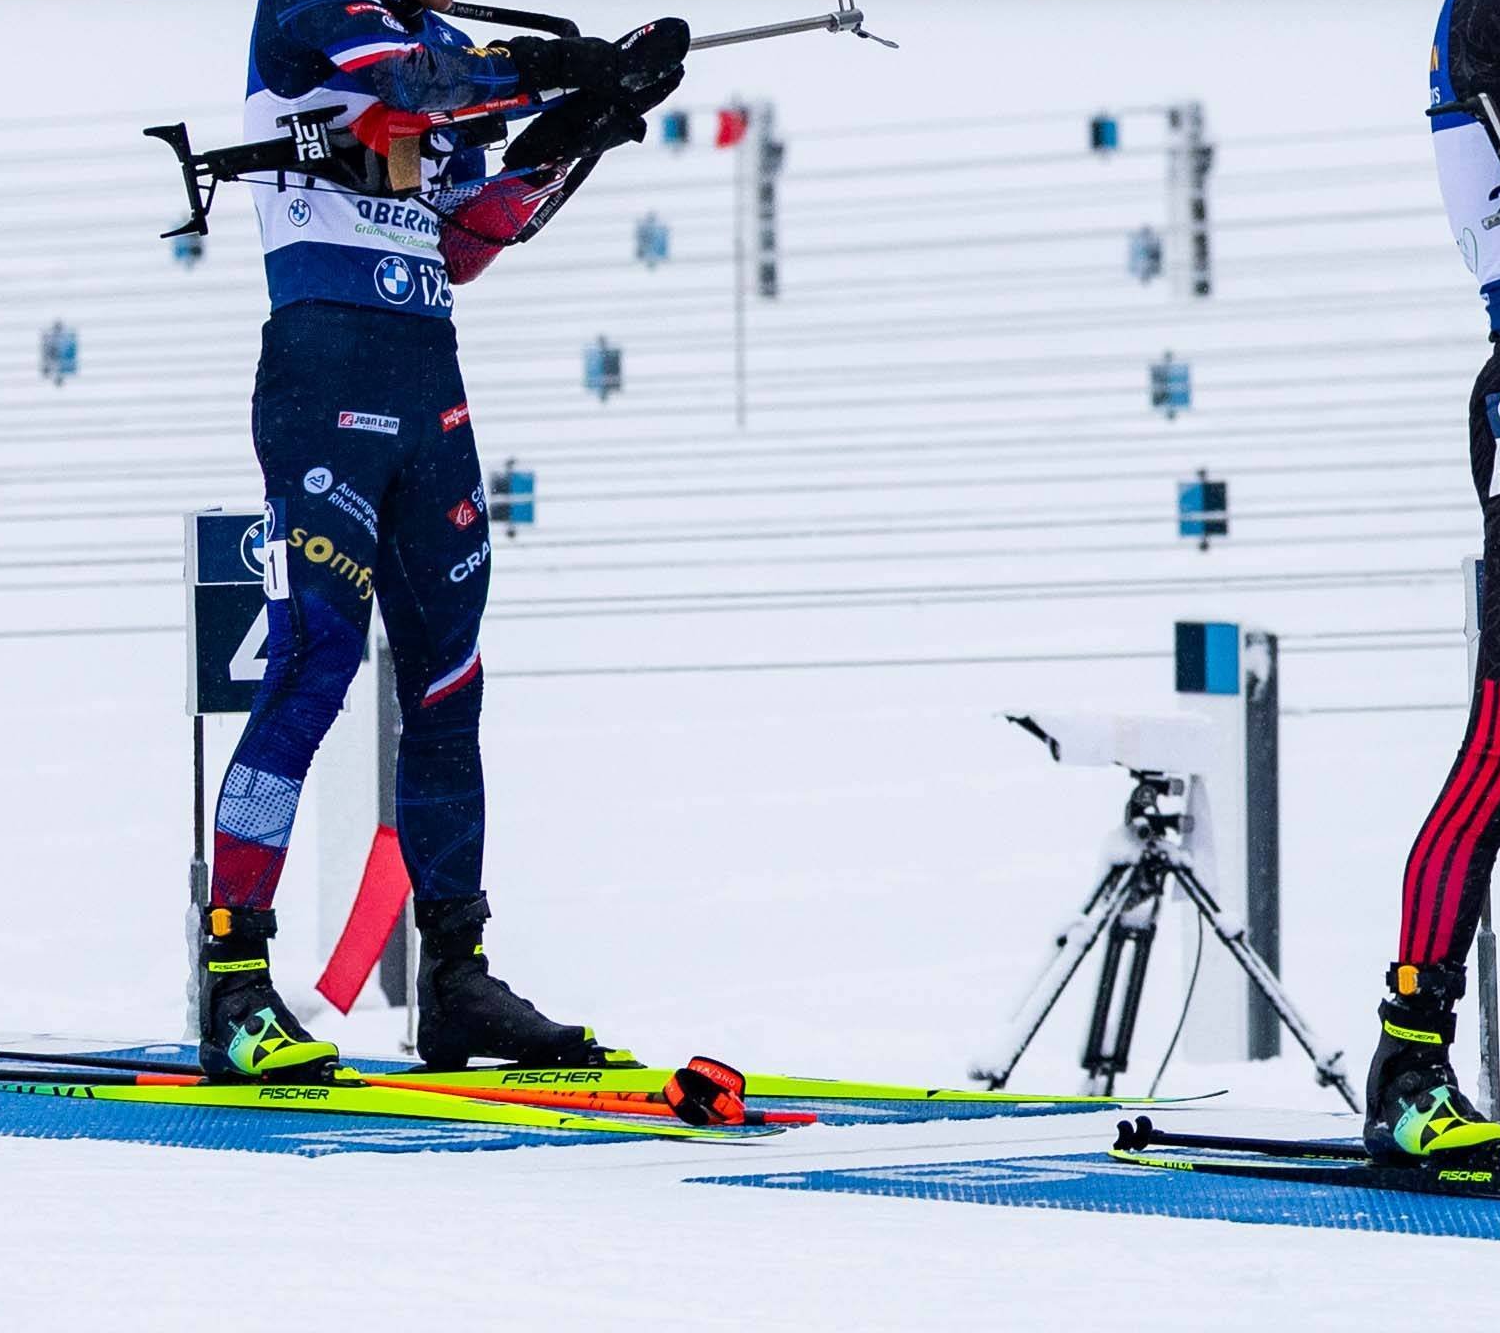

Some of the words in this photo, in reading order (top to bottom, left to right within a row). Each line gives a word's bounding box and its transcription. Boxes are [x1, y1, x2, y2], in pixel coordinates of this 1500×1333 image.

[287, 528, 375, 601] somfy
[449, 540, 491, 582] CRA
[501, 1071, 602, 1084] FISCHER
[259, 1087, 329, 1100] FISCHER
[1438, 1170, 1492, 1182] FISCHER
